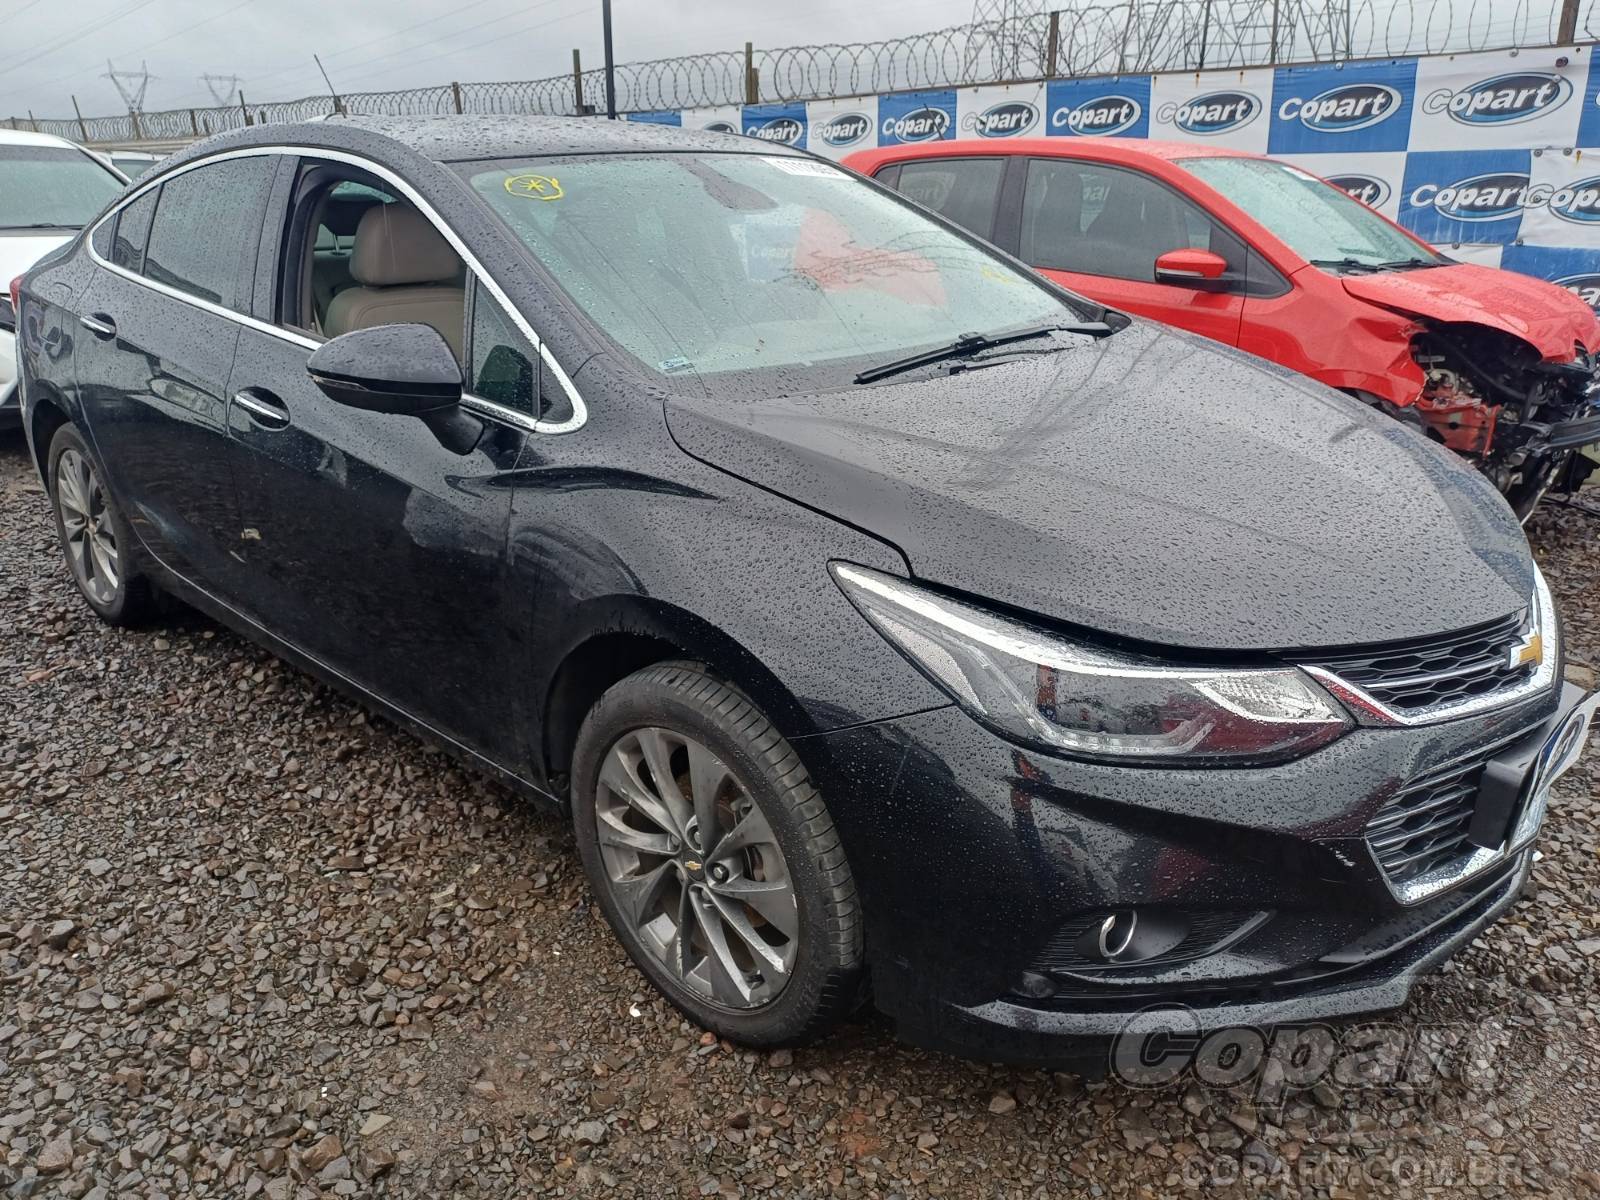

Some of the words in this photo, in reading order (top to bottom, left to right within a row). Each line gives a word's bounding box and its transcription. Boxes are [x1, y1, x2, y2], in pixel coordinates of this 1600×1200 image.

[1156, 98, 1249, 126] Copart
[1278, 93, 1388, 124] Copart
[1423, 82, 1552, 118] Copart
[811, 118, 865, 140] Copart
[882, 114, 942, 137] Copart
[961, 108, 1031, 134] Copart
[1052, 103, 1131, 130] Copart
[1524, 183, 1600, 213] Cop
